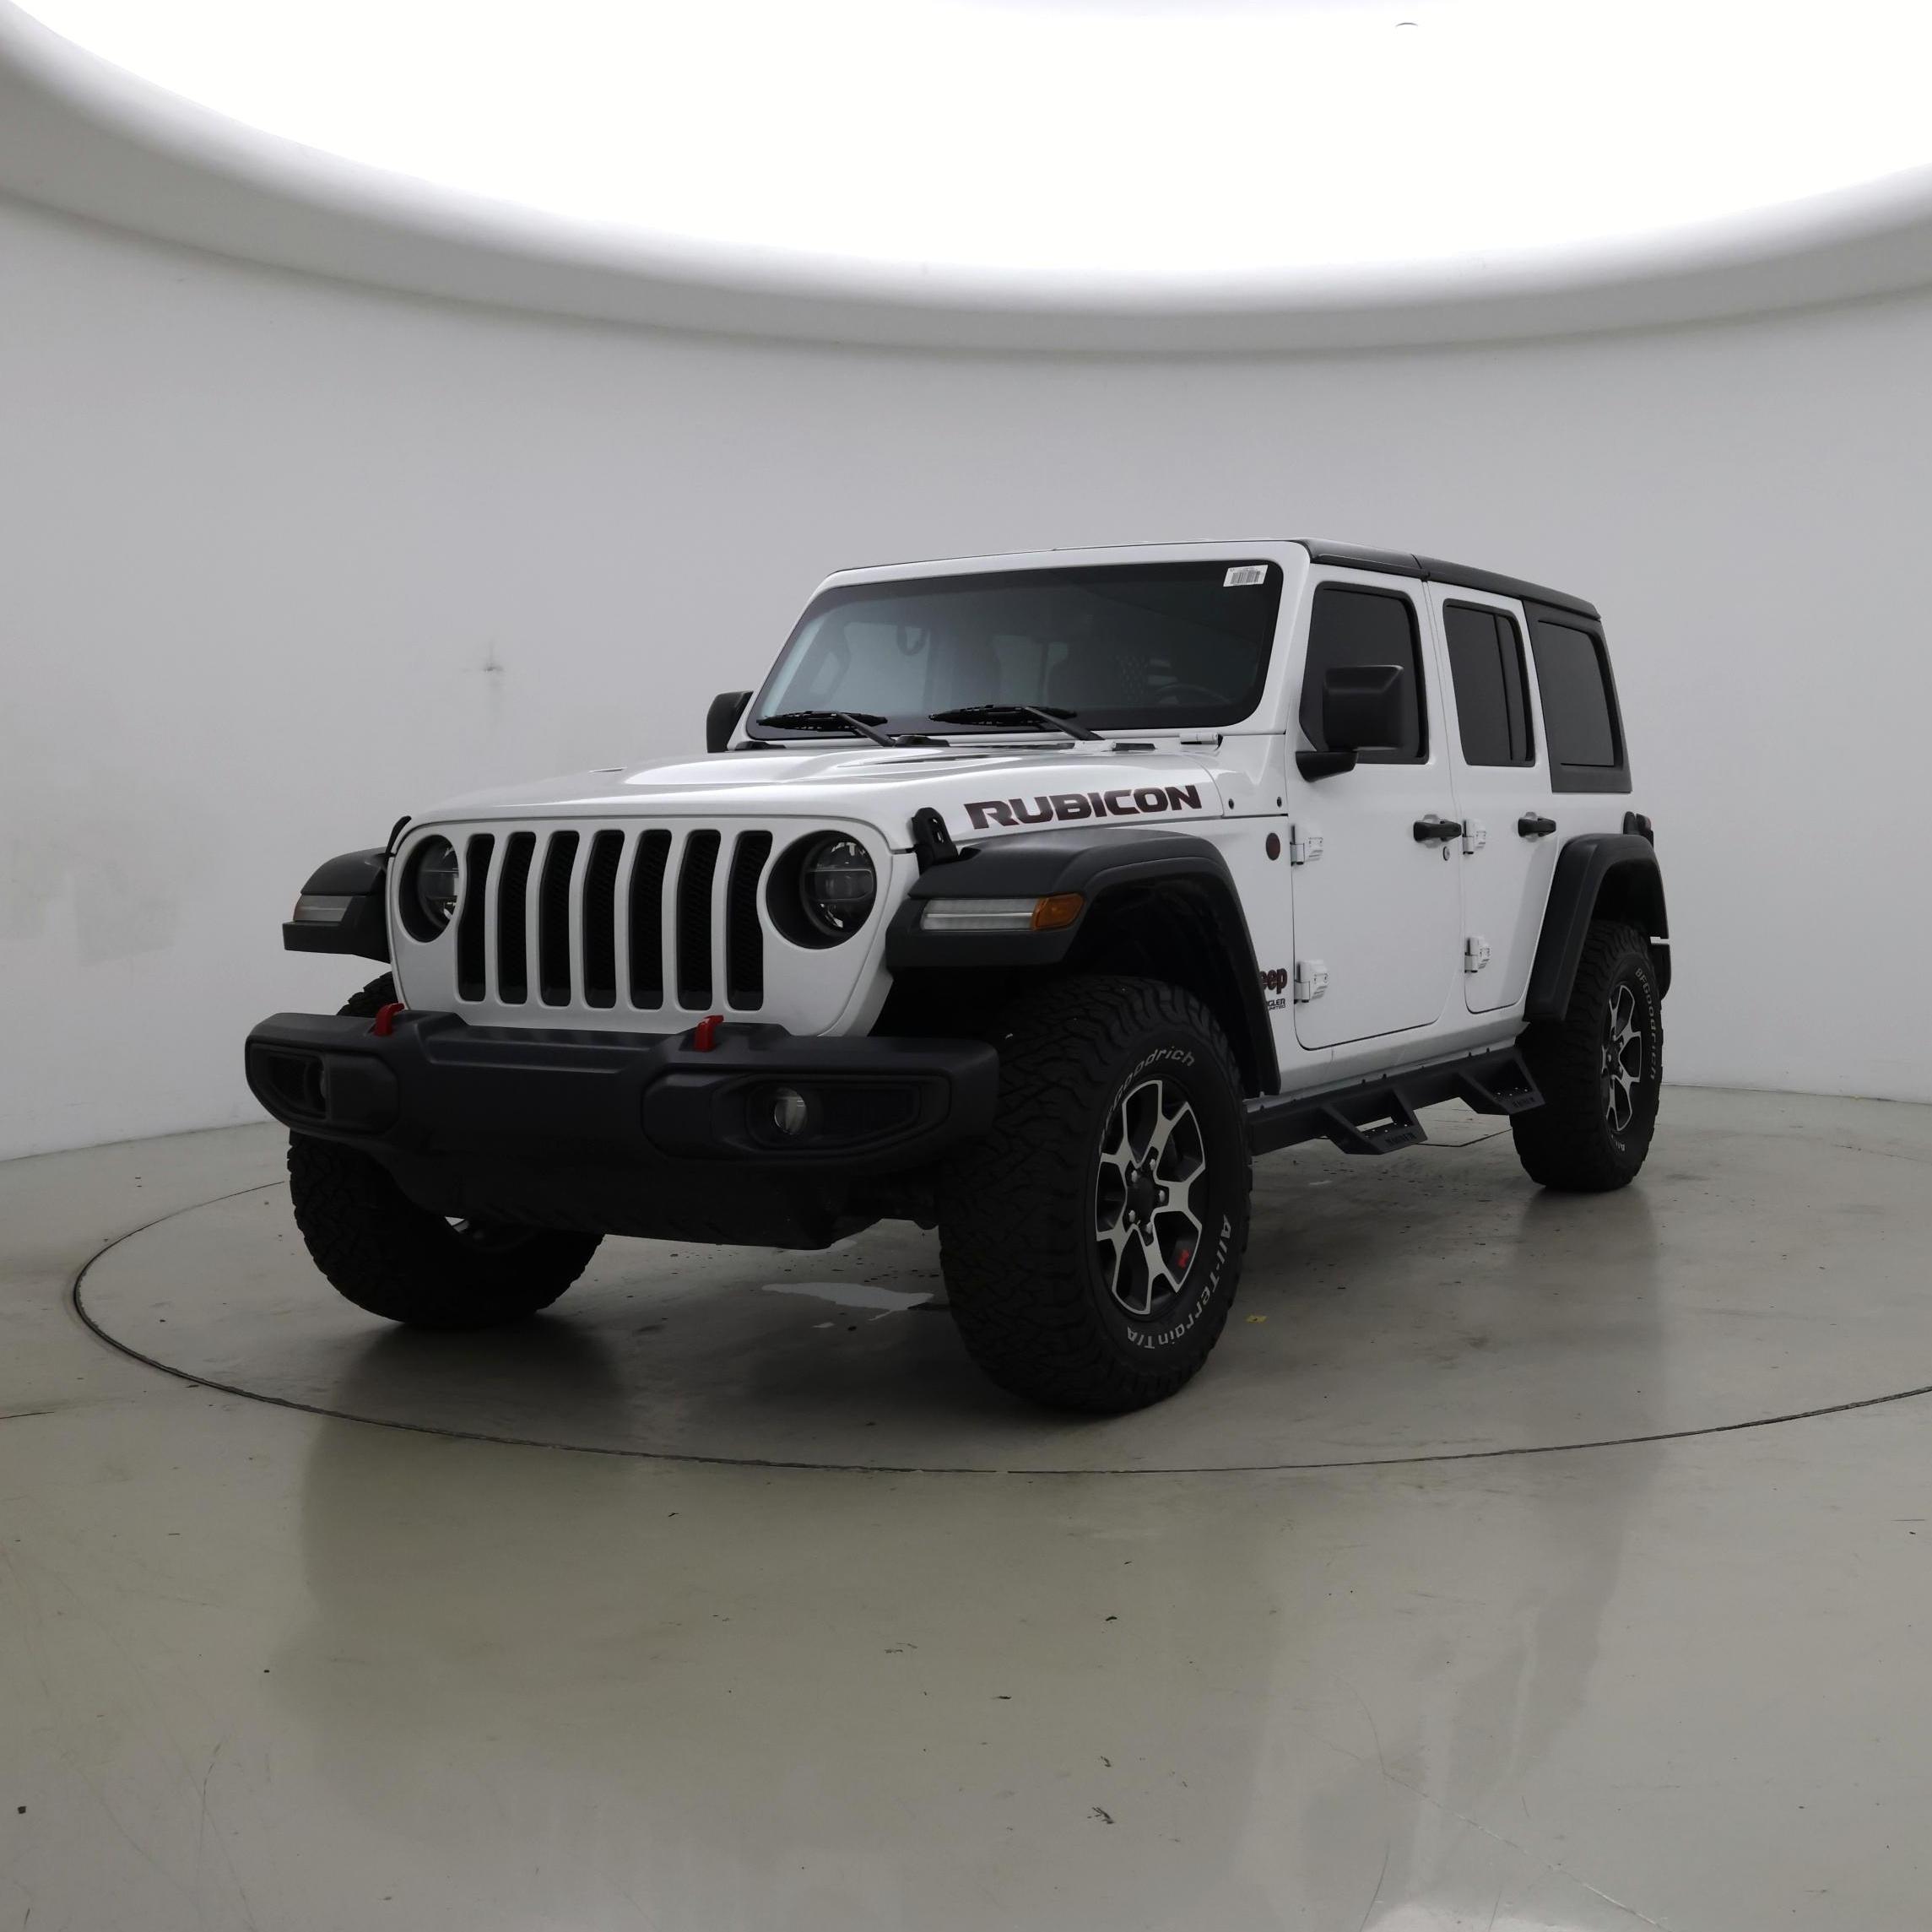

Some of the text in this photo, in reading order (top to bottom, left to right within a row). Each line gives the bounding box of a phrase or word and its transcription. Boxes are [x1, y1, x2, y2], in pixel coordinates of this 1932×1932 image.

[964, 785, 1203, 830] RUBICON
[1258, 968, 1287, 994] eep
[1158, 1214, 1232, 1345] All-Terrain
